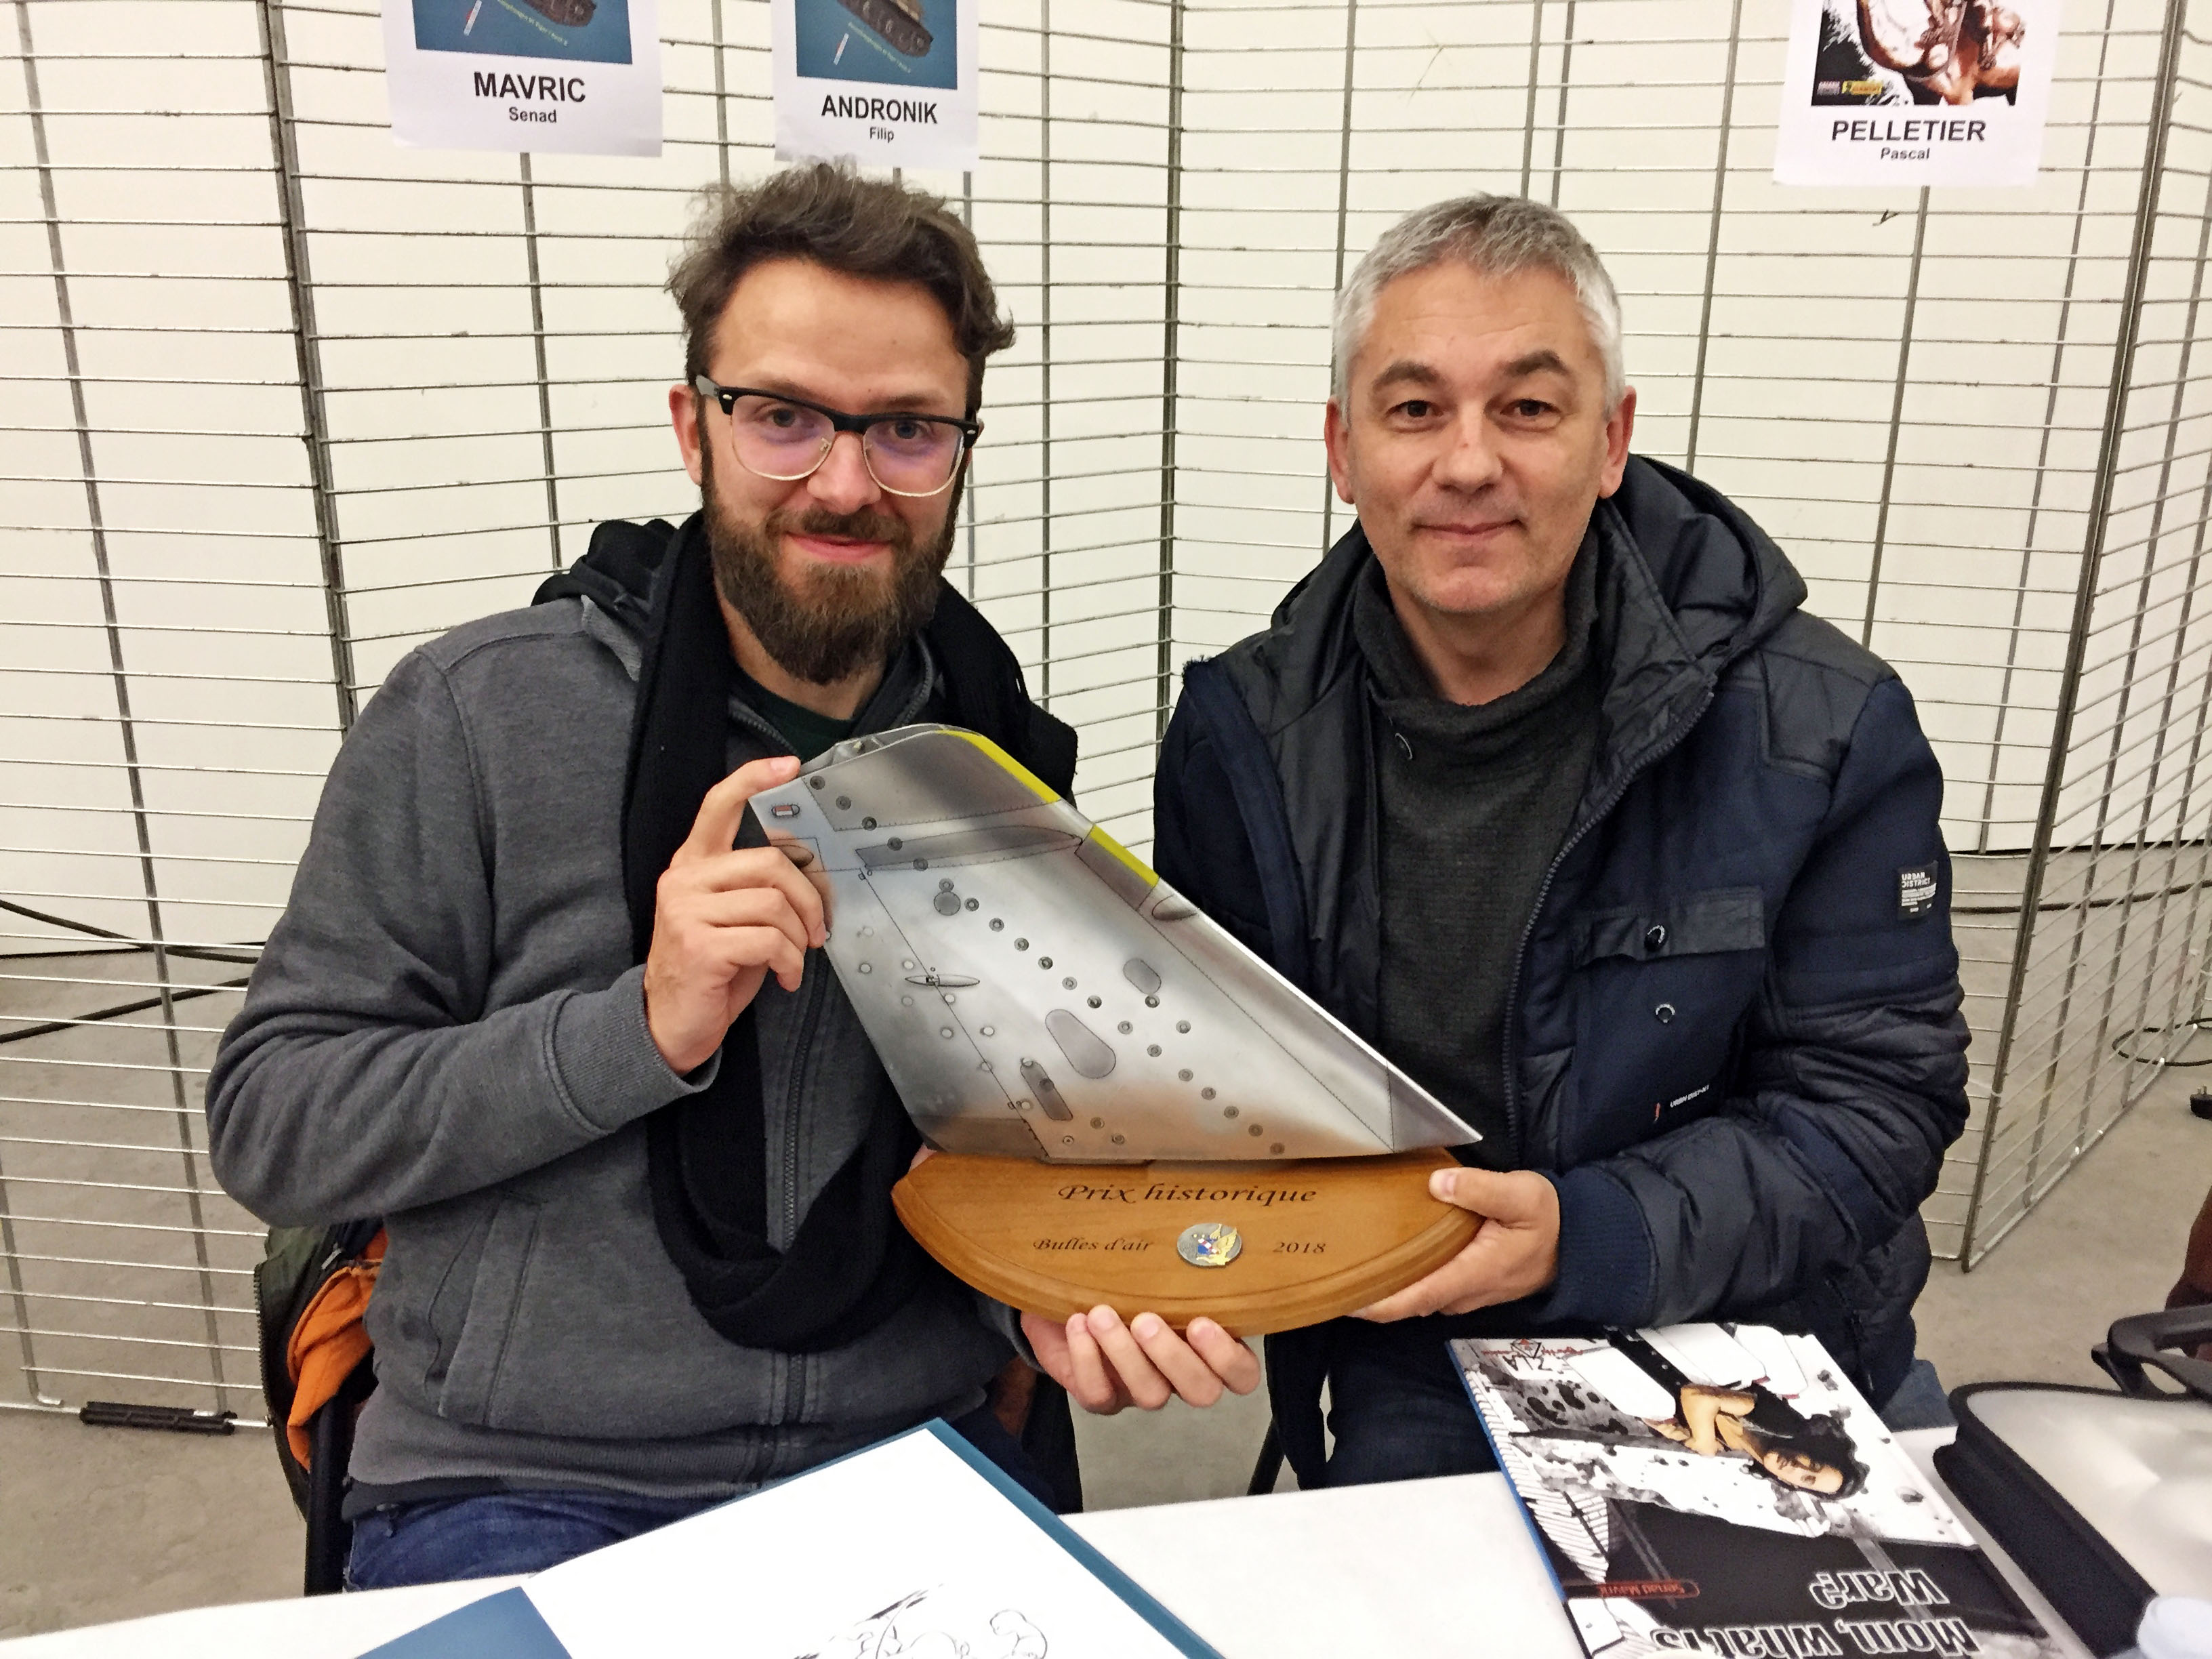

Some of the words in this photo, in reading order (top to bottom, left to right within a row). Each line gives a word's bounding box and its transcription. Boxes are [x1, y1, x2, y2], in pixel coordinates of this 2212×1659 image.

[474, 71, 586, 103] MAVRIC
[508, 106, 557, 123] Senad
[821, 94, 938, 124] ANDRONIK
[869, 126, 895, 143] Filip
[1831, 120, 1986, 142] PELLETIER
[1881, 147, 1931, 160] Pascal
[1901, 872, 1925, 881] URBAN
[1058, 1184, 1136, 1204] Prix
[1144, 1183, 1317, 1207] historique
[1032, 1237, 1097, 1252] Bulles
[1104, 1237, 1155, 1252] d'air
[1272, 1241, 1326, 1254] 2018
[1808, 1569, 1950, 1610] War?
[1703, 1623, 1844, 1659] what
[1835, 1618, 1984, 1657] Mom,
